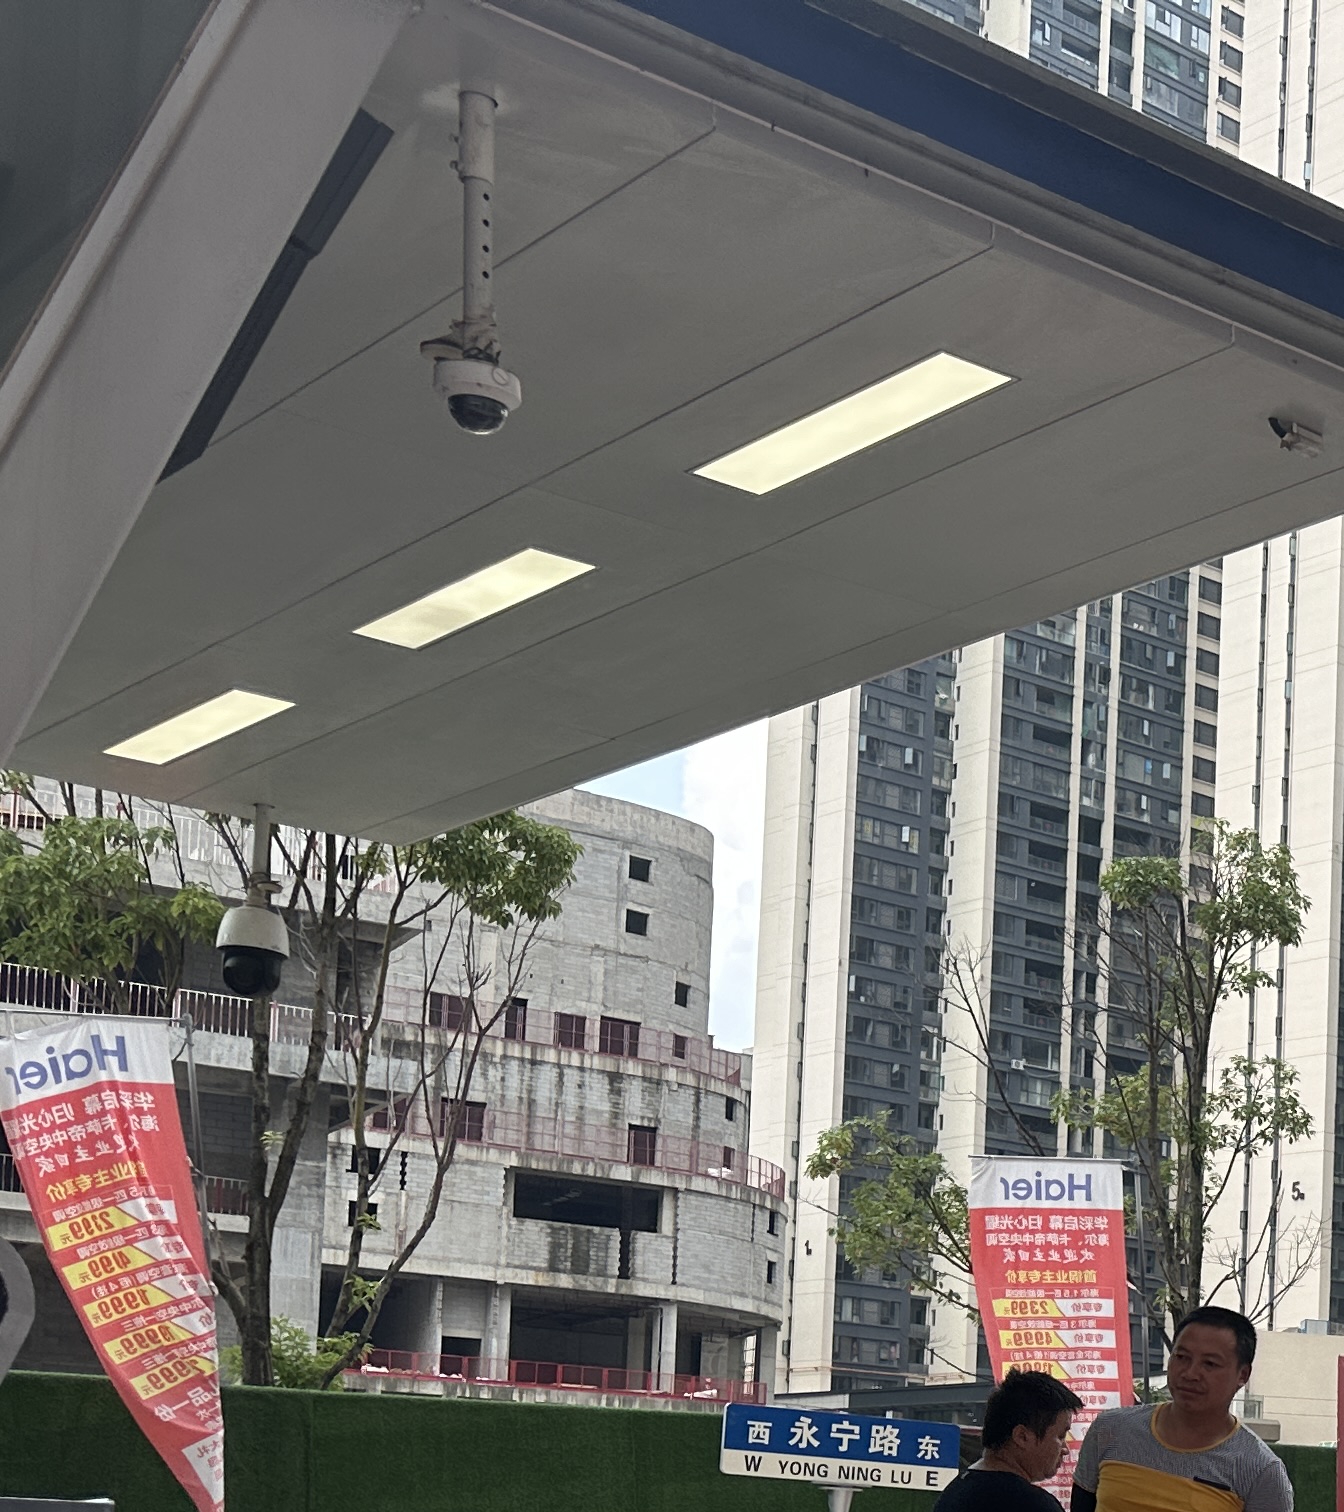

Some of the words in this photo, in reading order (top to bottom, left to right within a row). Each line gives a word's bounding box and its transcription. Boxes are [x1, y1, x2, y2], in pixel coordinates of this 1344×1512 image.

[747, 1420, 772, 1445] 西
[788, 1416, 901, 1457] 永宁路
[916, 1436, 941, 1460] 东
[744, 1455, 763, 1472] W
[778, 1460, 829, 1478] YONG
[838, 1465, 882, 1483] NING
[891, 1469, 912, 1485] LU
[926, 1471, 939, 1487] E
